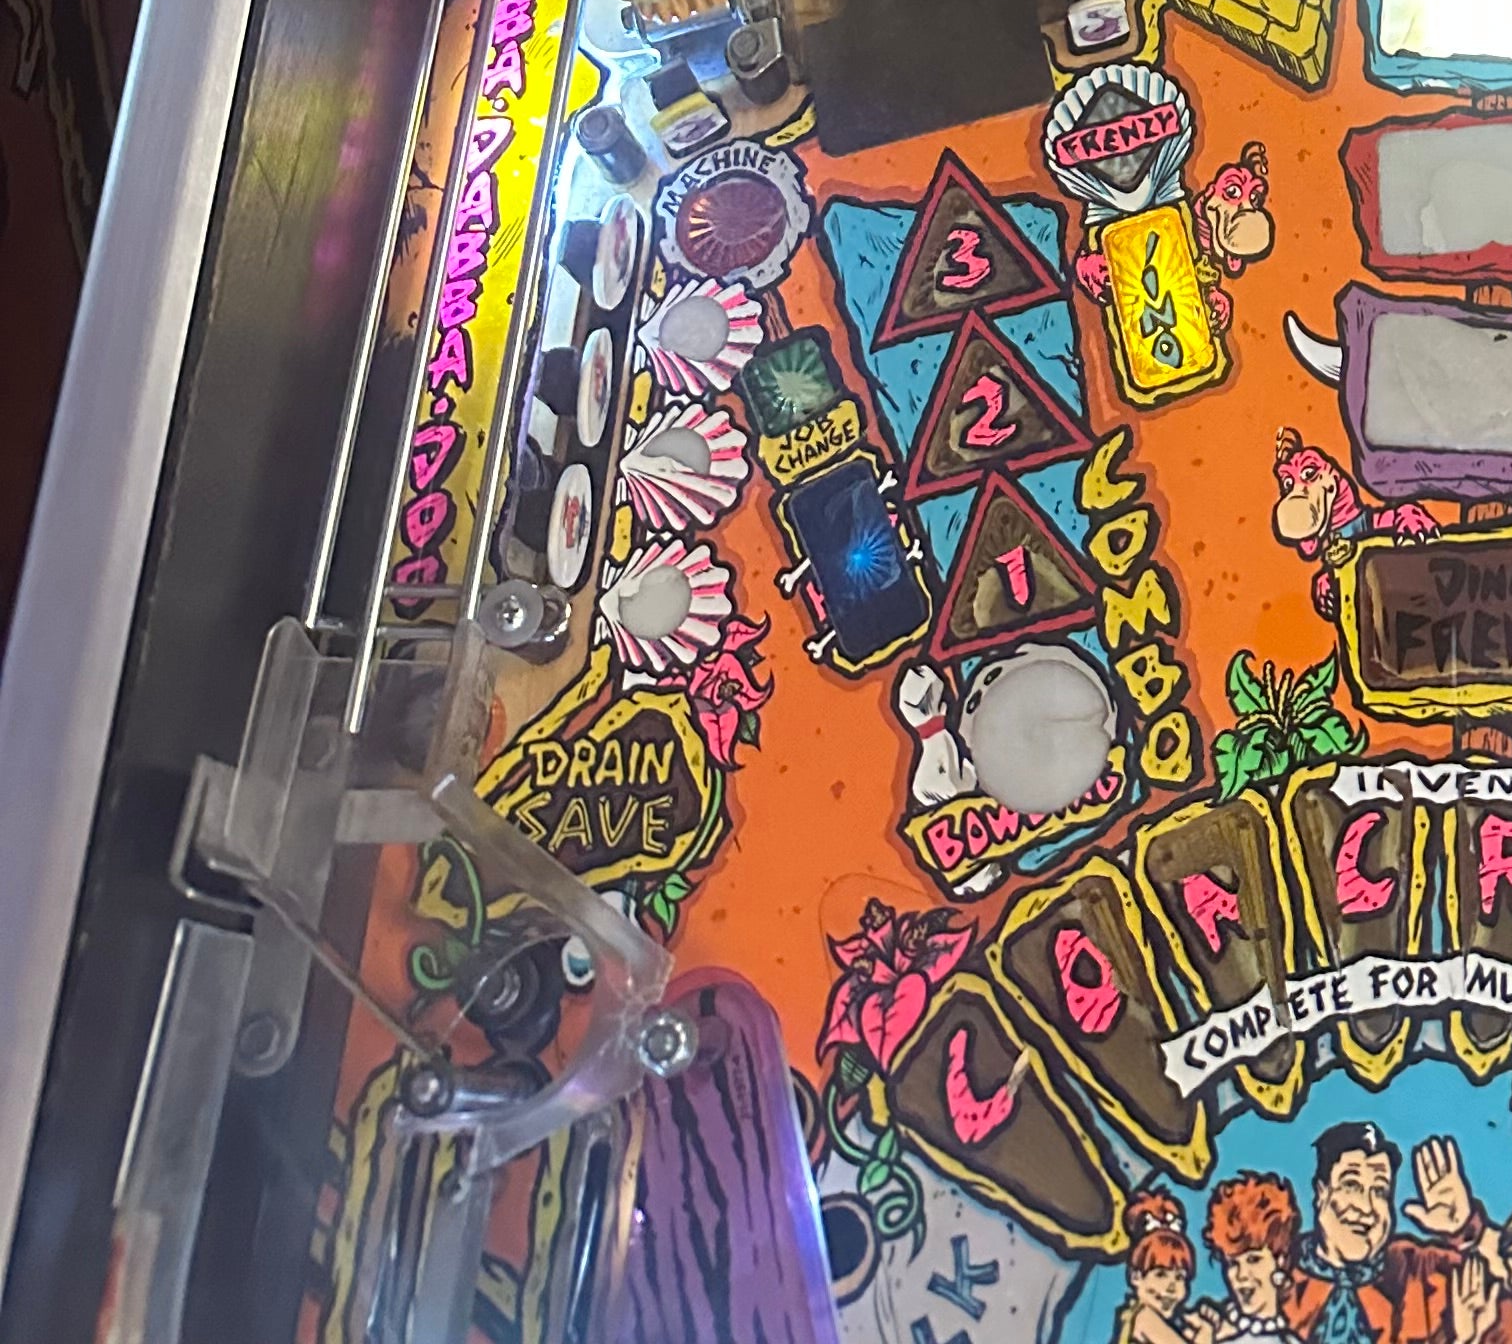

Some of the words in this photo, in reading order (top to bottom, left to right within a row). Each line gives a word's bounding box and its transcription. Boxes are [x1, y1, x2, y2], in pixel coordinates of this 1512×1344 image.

[1060, 108, 1176, 164] FRENZY
[662, 147, 777, 218] MACHINE
[937, 227, 993, 294] 3
[957, 370, 1018, 451] 2
[774, 419, 856, 475] CHANGE
[994, 542, 1033, 612] 1
[528, 739, 675, 788] DRAIN
[512, 794, 673, 855] SAVE
[1182, 975, 1354, 1069] COMPETE
[1371, 966, 1439, 1001] FOR
